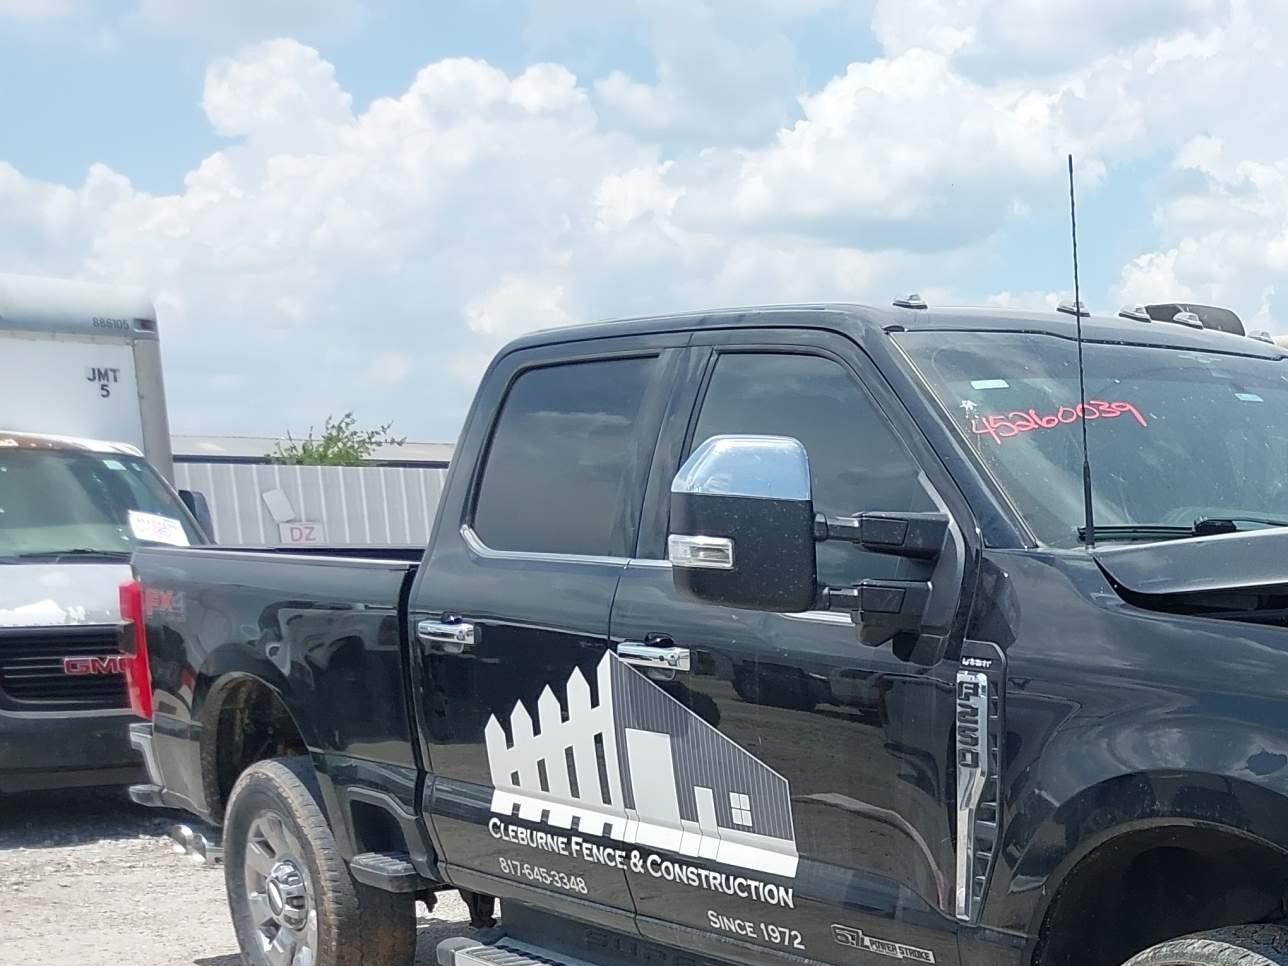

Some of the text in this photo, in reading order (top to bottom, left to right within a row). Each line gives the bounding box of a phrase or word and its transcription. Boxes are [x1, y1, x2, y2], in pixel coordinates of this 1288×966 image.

[87, 367, 120, 383] JMT
[100, 383, 111, 399] 5
[971, 400, 1148, 445] 45260039
[290, 526, 317, 542] DZ
[488, 817, 795, 909] CLEBURNE FENCE & CONSTRUCTION
[499, 857, 588, 894] 817-645-3348
[707, 910, 806, 950] SINCE 1972
